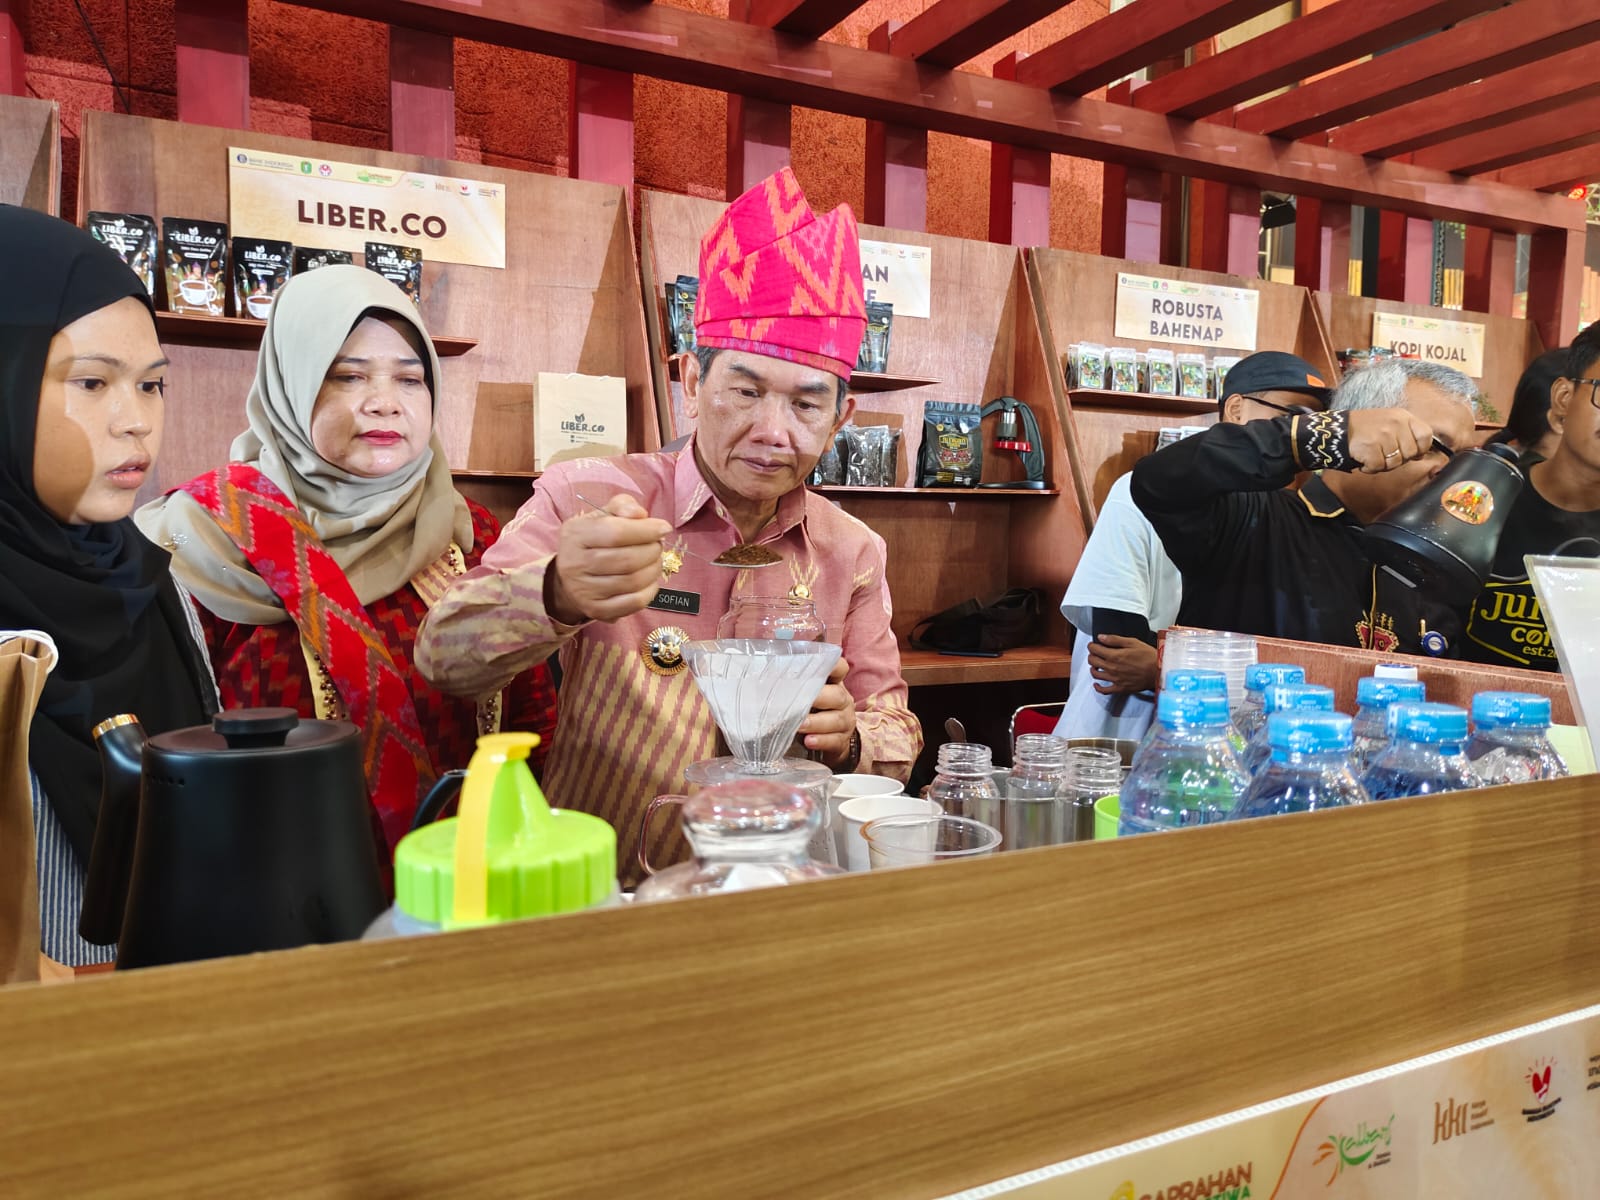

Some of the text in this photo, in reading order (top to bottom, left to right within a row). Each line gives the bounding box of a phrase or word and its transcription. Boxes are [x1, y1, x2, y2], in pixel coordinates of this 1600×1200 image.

[298, 200, 447, 239] LIBER.CO
[862, 263, 889, 283] AN
[1151, 298, 1224, 321] ROBUSTA
[1149, 320, 1224, 342] BAHENAP
[1390, 340, 1467, 362] KOPI KOJAL
[658, 593, 690, 608] SOFIAN
[1522, 645, 1558, 658] est.2
